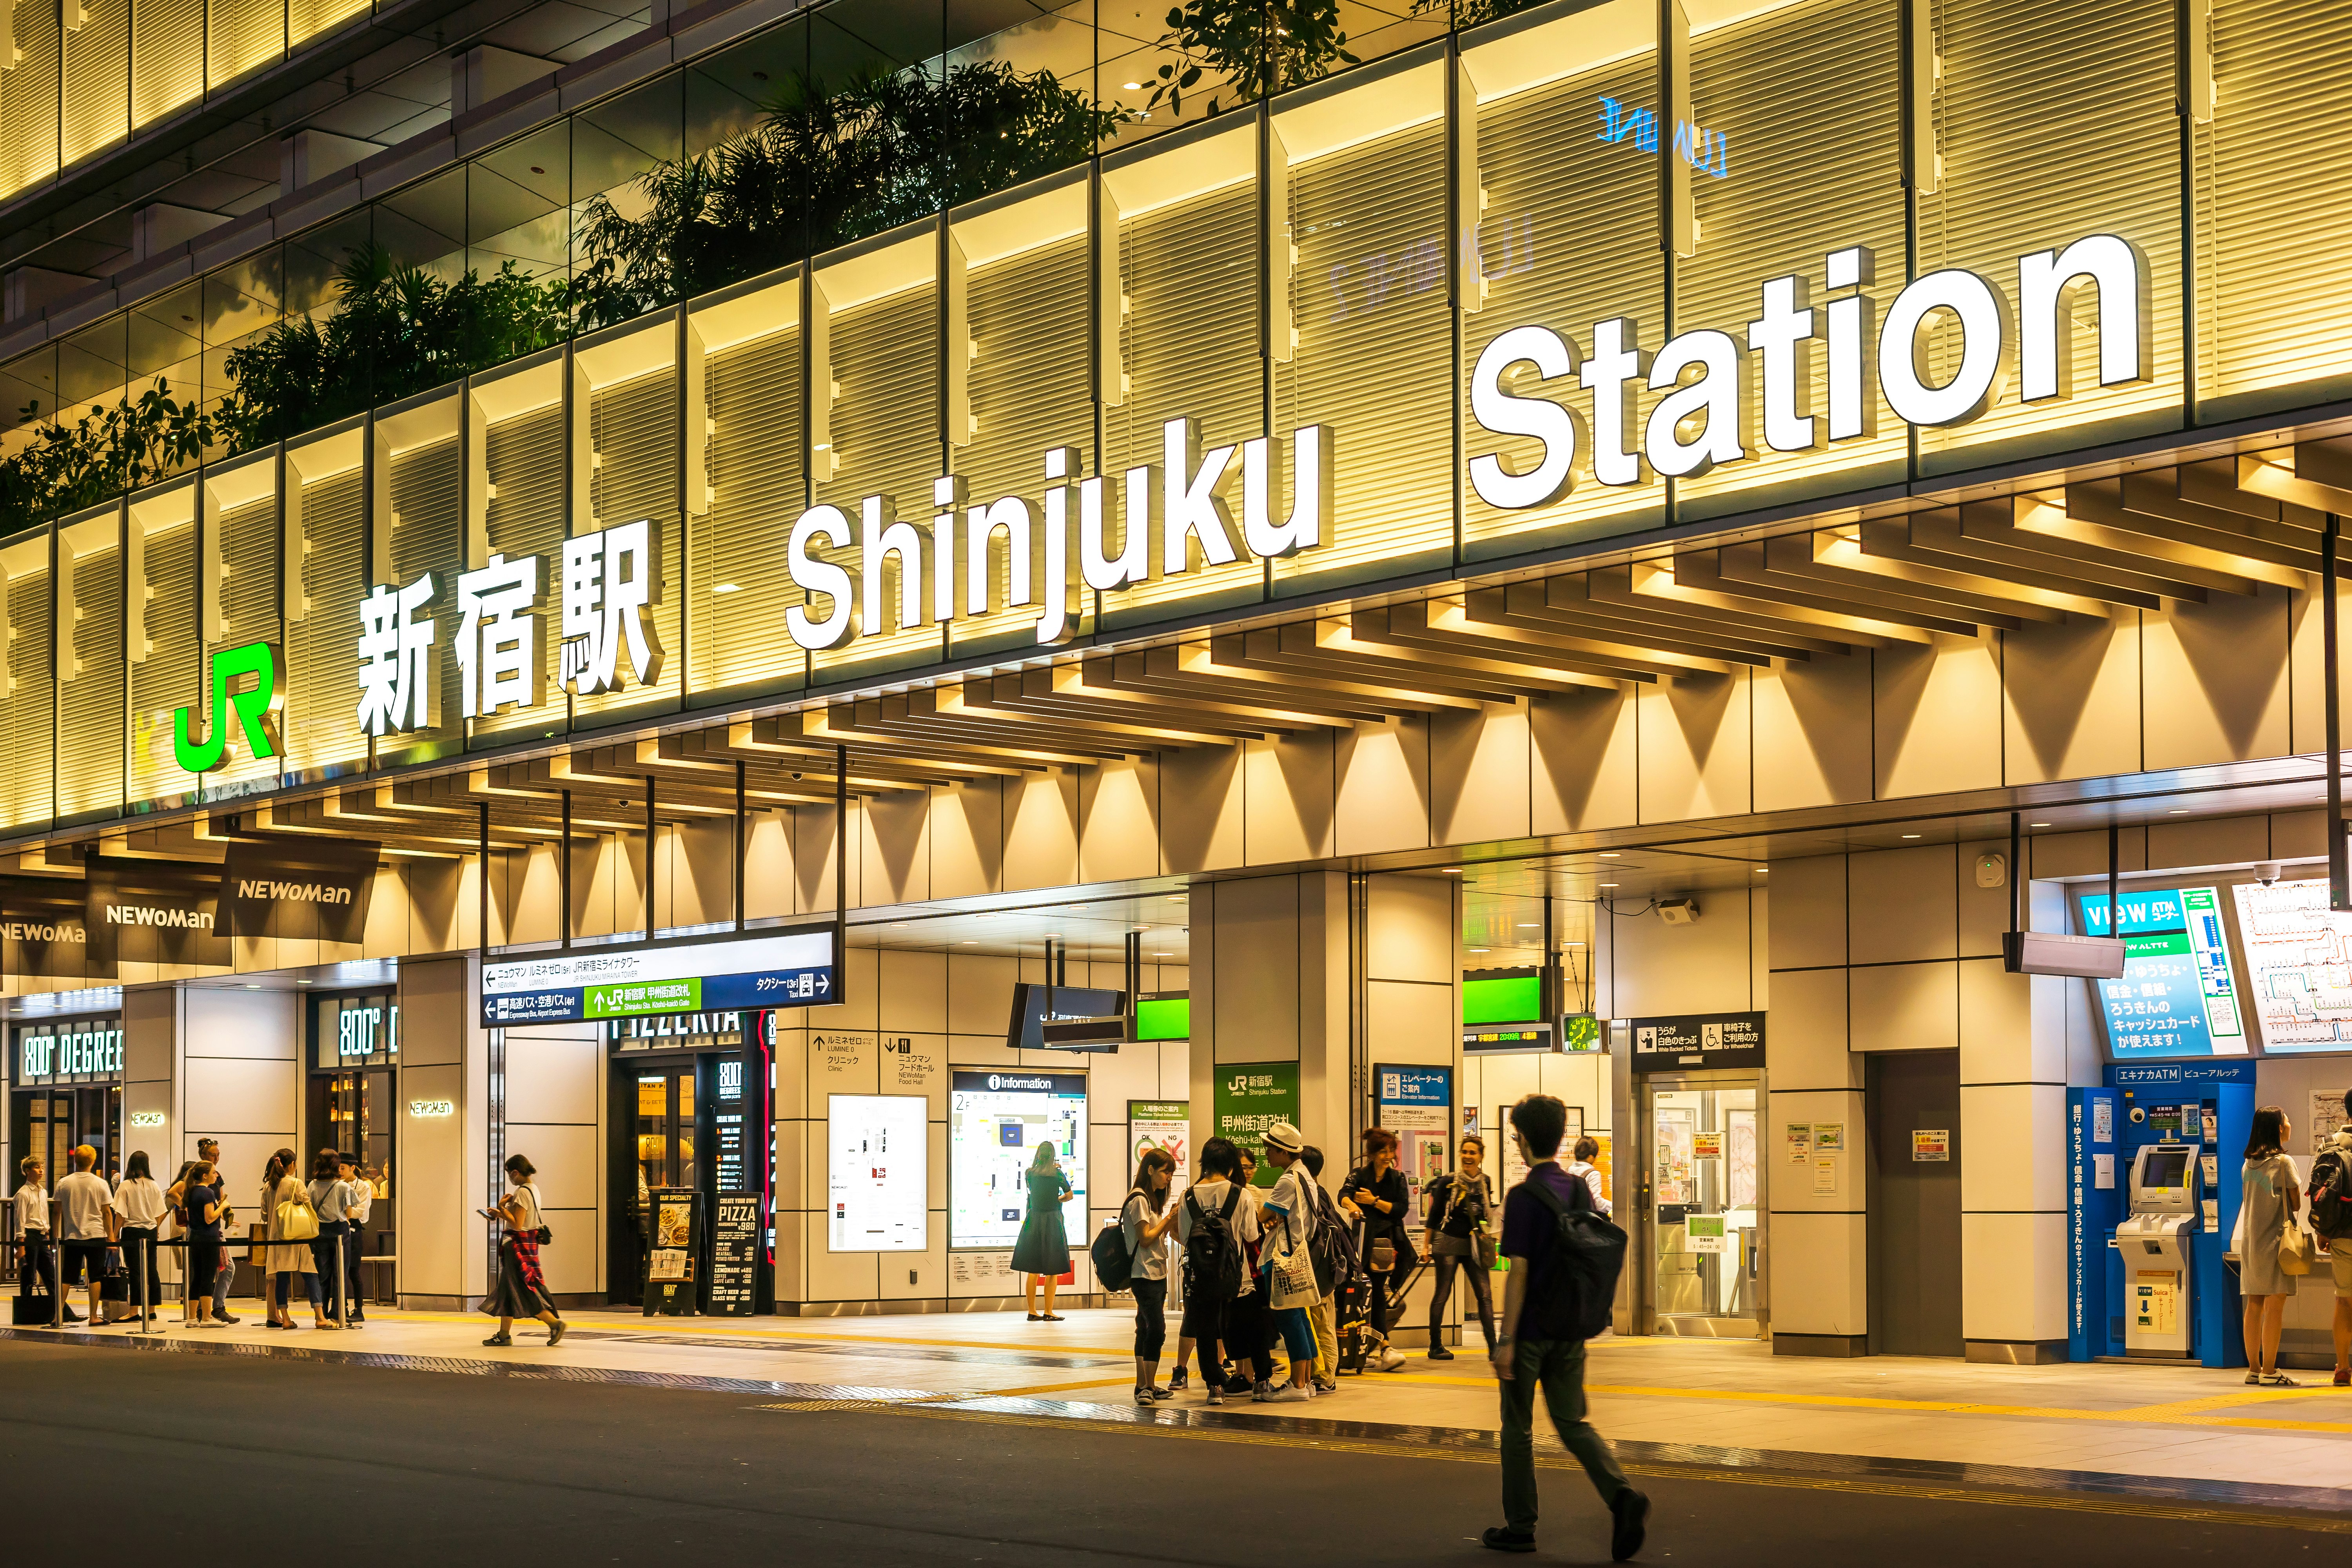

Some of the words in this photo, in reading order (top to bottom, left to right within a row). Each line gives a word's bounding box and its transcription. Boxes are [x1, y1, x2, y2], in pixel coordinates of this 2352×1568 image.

[174, 641, 274, 772] JR
[356, 519, 663, 736] 新宿駅
[786, 419, 1329, 647] Shinjuku
[1470, 234, 2141, 507] Station
[239, 880, 350, 904] NEWoMan
[2152, 901, 2176, 913] ATM
[107, 905, 214, 928] NEWoMan
[2152, 912, 2180, 921] コーナー
[0, 923, 86, 943] NEWoMa
[498, 967, 526, 978] ニュウマン
[607, 989, 624, 1005] JR
[624, 987, 646, 1001] 新宿駅
[648, 984, 690, 999] 甲州街道改札
[624, 1003, 642, 1011] Shinjuku
[2111, 1000, 2170, 1016] ろうきんの
[510, 1011, 529, 1020] Expressway
[549, 1009, 563, 1017] Express
[1724, 1023, 1752, 1032] 車椅子を
[2114, 1015, 2200, 1031] キャッシュカード
[1658, 1026, 1676, 1035] うらが
[828, 1036, 862, 1045] ルミネゼロ
[1478, 1033, 1499, 1042] 宇都宮線
[1499, 1033, 1520, 1041] 20:09発
[1522, 1032, 1537, 1040] 4番線
[1658, 1035, 1697, 1046] 白色のきっぷ
[1724, 1033, 1759, 1042] ご利用の方
[828, 1056, 859, 1065] クリニック
[898, 1063, 935, 1072] フードホール
[720, 1062, 742, 1087] 800
[1401, 1074, 1443, 1083] エレベーターの
[2120, 1069, 2177, 1080] エキナカATM
[2185, 1069, 2240, 1078] ビューアルッテ
[1001, 1077, 1051, 1089] Information
[1228, 1076, 1247, 1091] JR
[1249, 1075, 1273, 1087] 新宿駅
[1401, 1084, 1420, 1093] ご案内
[718, 1206, 756, 1221] PIZZA
